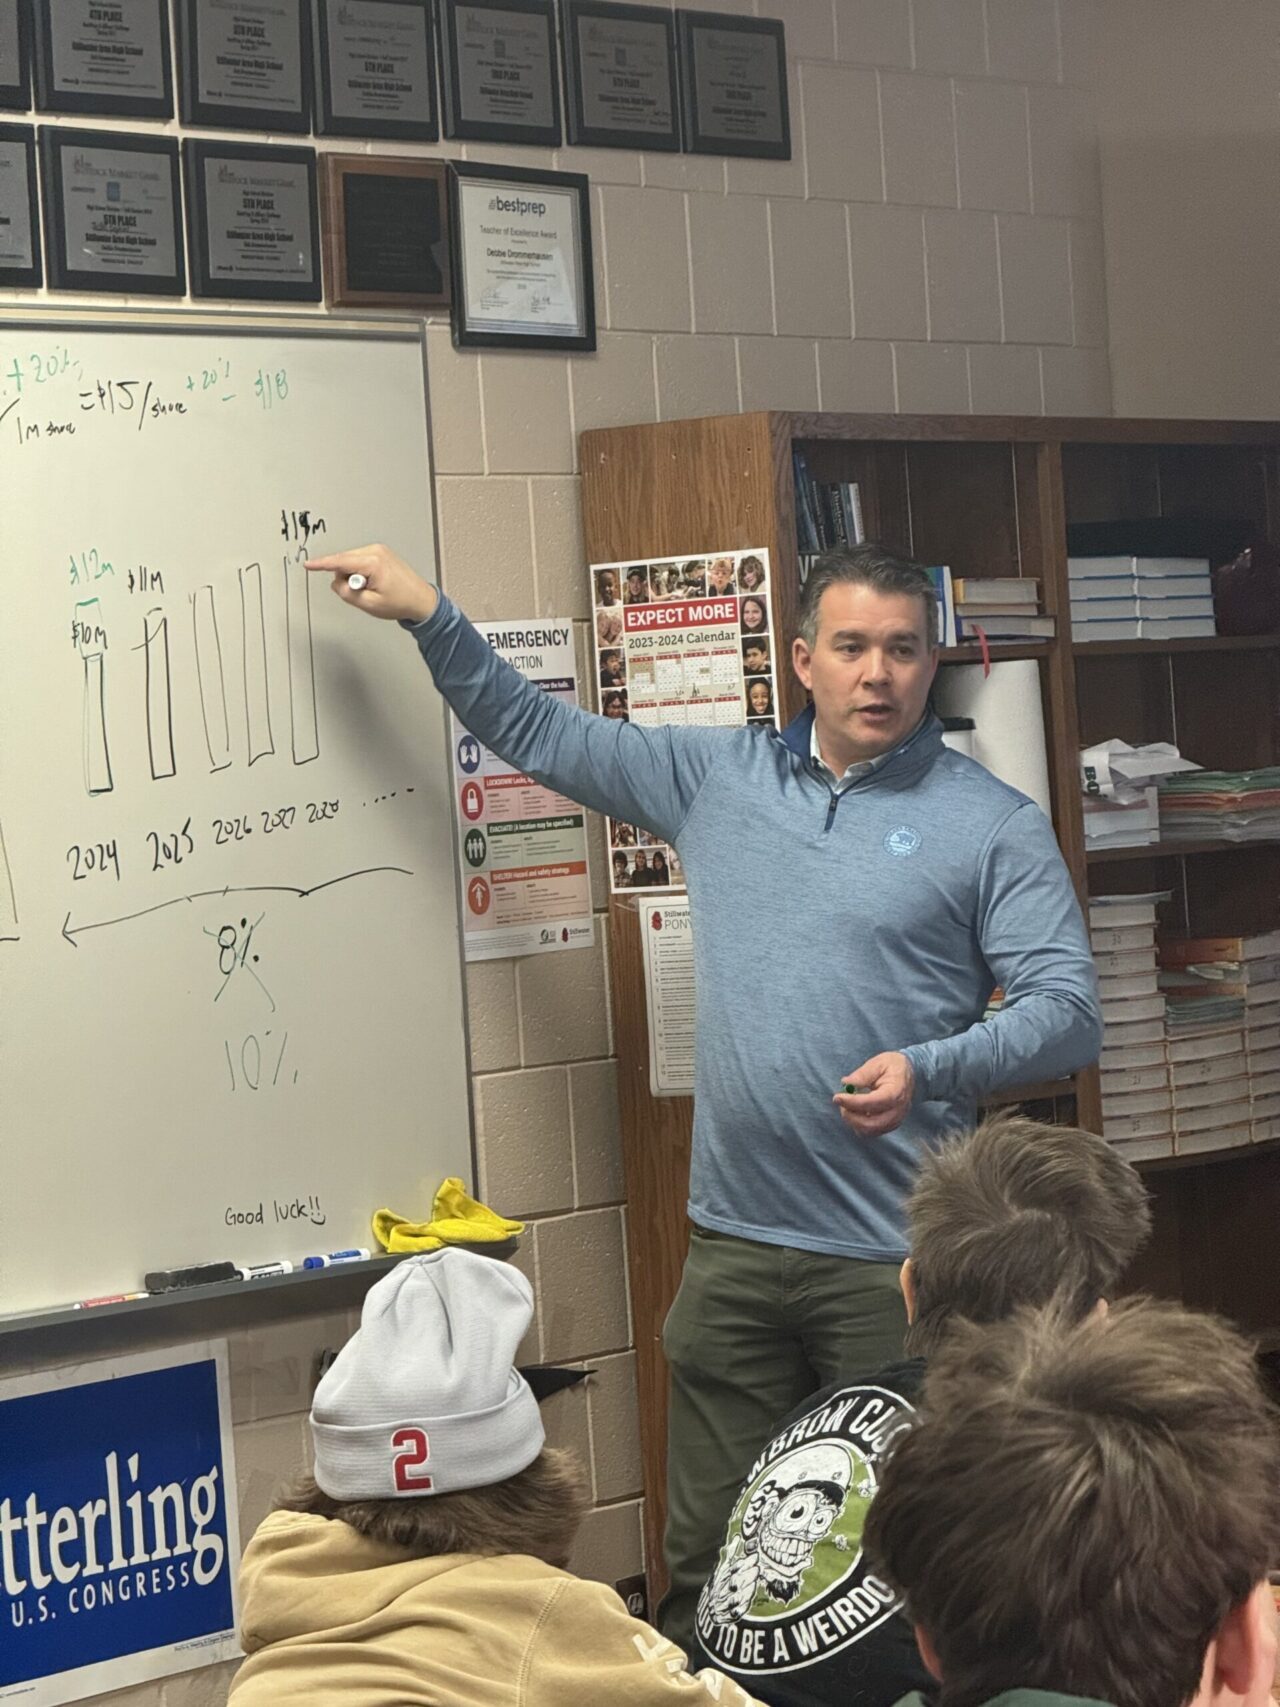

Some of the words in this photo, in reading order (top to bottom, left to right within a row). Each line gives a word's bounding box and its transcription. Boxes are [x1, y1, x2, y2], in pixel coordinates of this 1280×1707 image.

[496, 195, 546, 217] bestprep
[627, 608, 684, 628] EXPECT
[688, 603, 736, 622] MORE
[486, 628, 570, 650] EMERGENCY
[628, 633, 684, 649] 2023-2024
[686, 630, 736, 645] Calendar
[67, 839, 120, 881] 2024
[146, 817, 194, 871] 2025
[212, 815, 252, 845] 2026
[261, 806, 296, 834] 2027
[225, 1202, 264, 1226] Good
[391, 1427, 434, 1494] 2
[0, 1450, 225, 1597] tterling
[11, 1596, 57, 1627] U.S.
[68, 1561, 190, 1614] CONGRESS
[715, 1623, 738, 1660] TO
[739, 1628, 766, 1665] BE
[772, 1628, 790, 1664] A
[791, 1574, 895, 1656] WEIRDO
